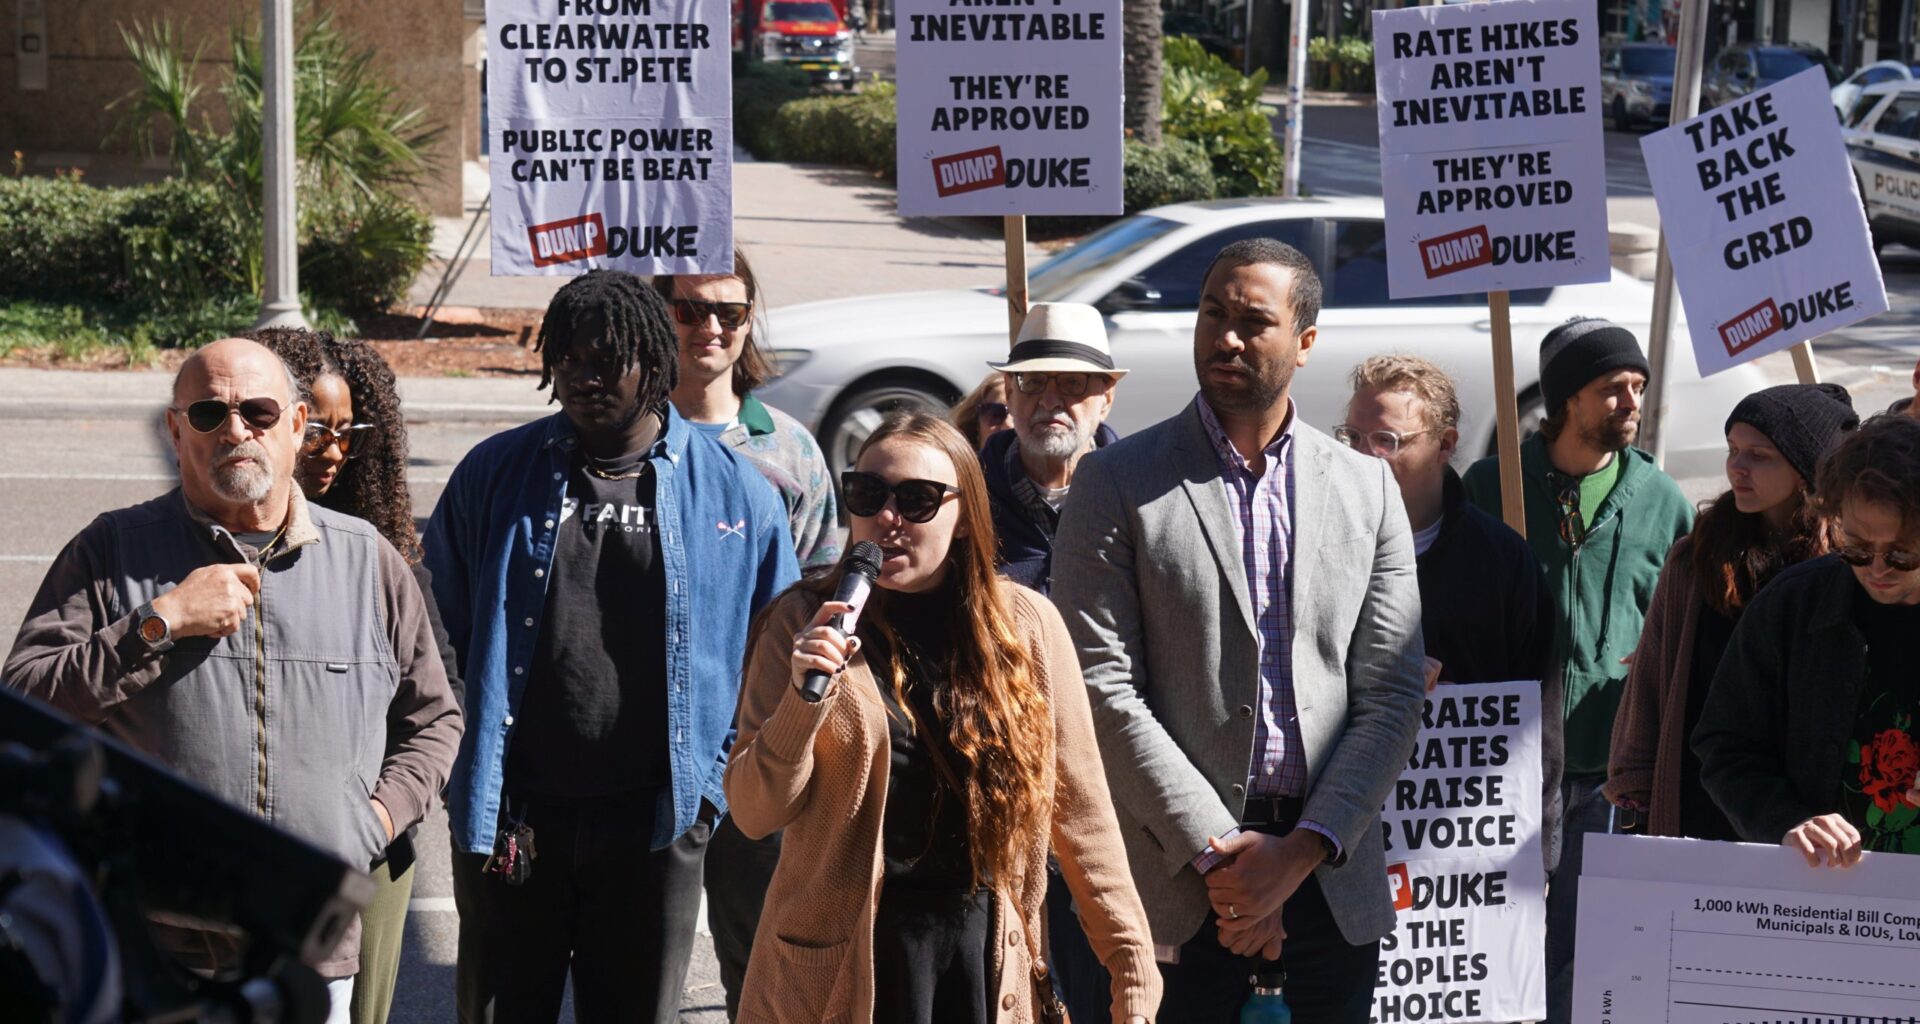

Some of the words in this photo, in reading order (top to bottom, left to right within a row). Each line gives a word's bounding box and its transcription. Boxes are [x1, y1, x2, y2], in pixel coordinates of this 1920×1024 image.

[558, 0, 650, 16] FROM
[500, 23, 711, 51] CLEARWATER
[910, 13, 1105, 42] INEVITABLE
[1393, 27, 1473, 59] RATE
[1481, 19, 1579, 52] HIKES
[525, 58, 566, 83] TO
[576, 57, 692, 83] ST.PETE
[949, 75, 1069, 100] THEY'RE
[1430, 56, 1546, 90] AREN'T
[931, 106, 1090, 131] APPROVED
[1393, 87, 1586, 127] INEVITABLE
[1684, 93, 1778, 153] TAKE
[503, 129, 603, 153] PUBLIC
[611, 128, 714, 152] POWER
[511, 158, 595, 183] CAN'T
[603, 158, 635, 182] BE
[643, 158, 713, 181] BEAT
[939, 154, 998, 189] DUMP
[1005, 158, 1091, 188] DUKE
[1433, 151, 1552, 183] THEY'RE
[1696, 127, 1796, 191] BACK
[1416, 180, 1573, 215] APPROVED
[1717, 172, 1786, 222] THE
[1875, 173, 1920, 200] POLIC
[535, 222, 598, 259] DUMP
[607, 226, 699, 258] DUKE
[1426, 233, 1485, 270] DUMP
[1492, 231, 1576, 266] DUKE
[1723, 216, 1814, 271] GRID
[1725, 306, 1774, 349] DUMP
[1780, 281, 1855, 331] DUKE
[1422, 694, 1520, 730] RAISE
[1396, 776, 1503, 811] RAISE
[1402, 815, 1516, 850] VOICE
[1412, 871, 1507, 911] DUKE
[1693, 898, 1732, 913] 1,000
[1736, 901, 1768, 915] kWh
[1773, 904, 1852, 922] Residential
[1857, 911, 1879, 923] Bill
[1406, 919, 1465, 950] THE
[1756, 917, 1834, 935] Municipals
[1838, 923, 1850, 936] &
[1855, 925, 1894, 941] IOUs,
[1375, 953, 1488, 988] EOPLES
[1602, 990, 1612, 1015] kWh
